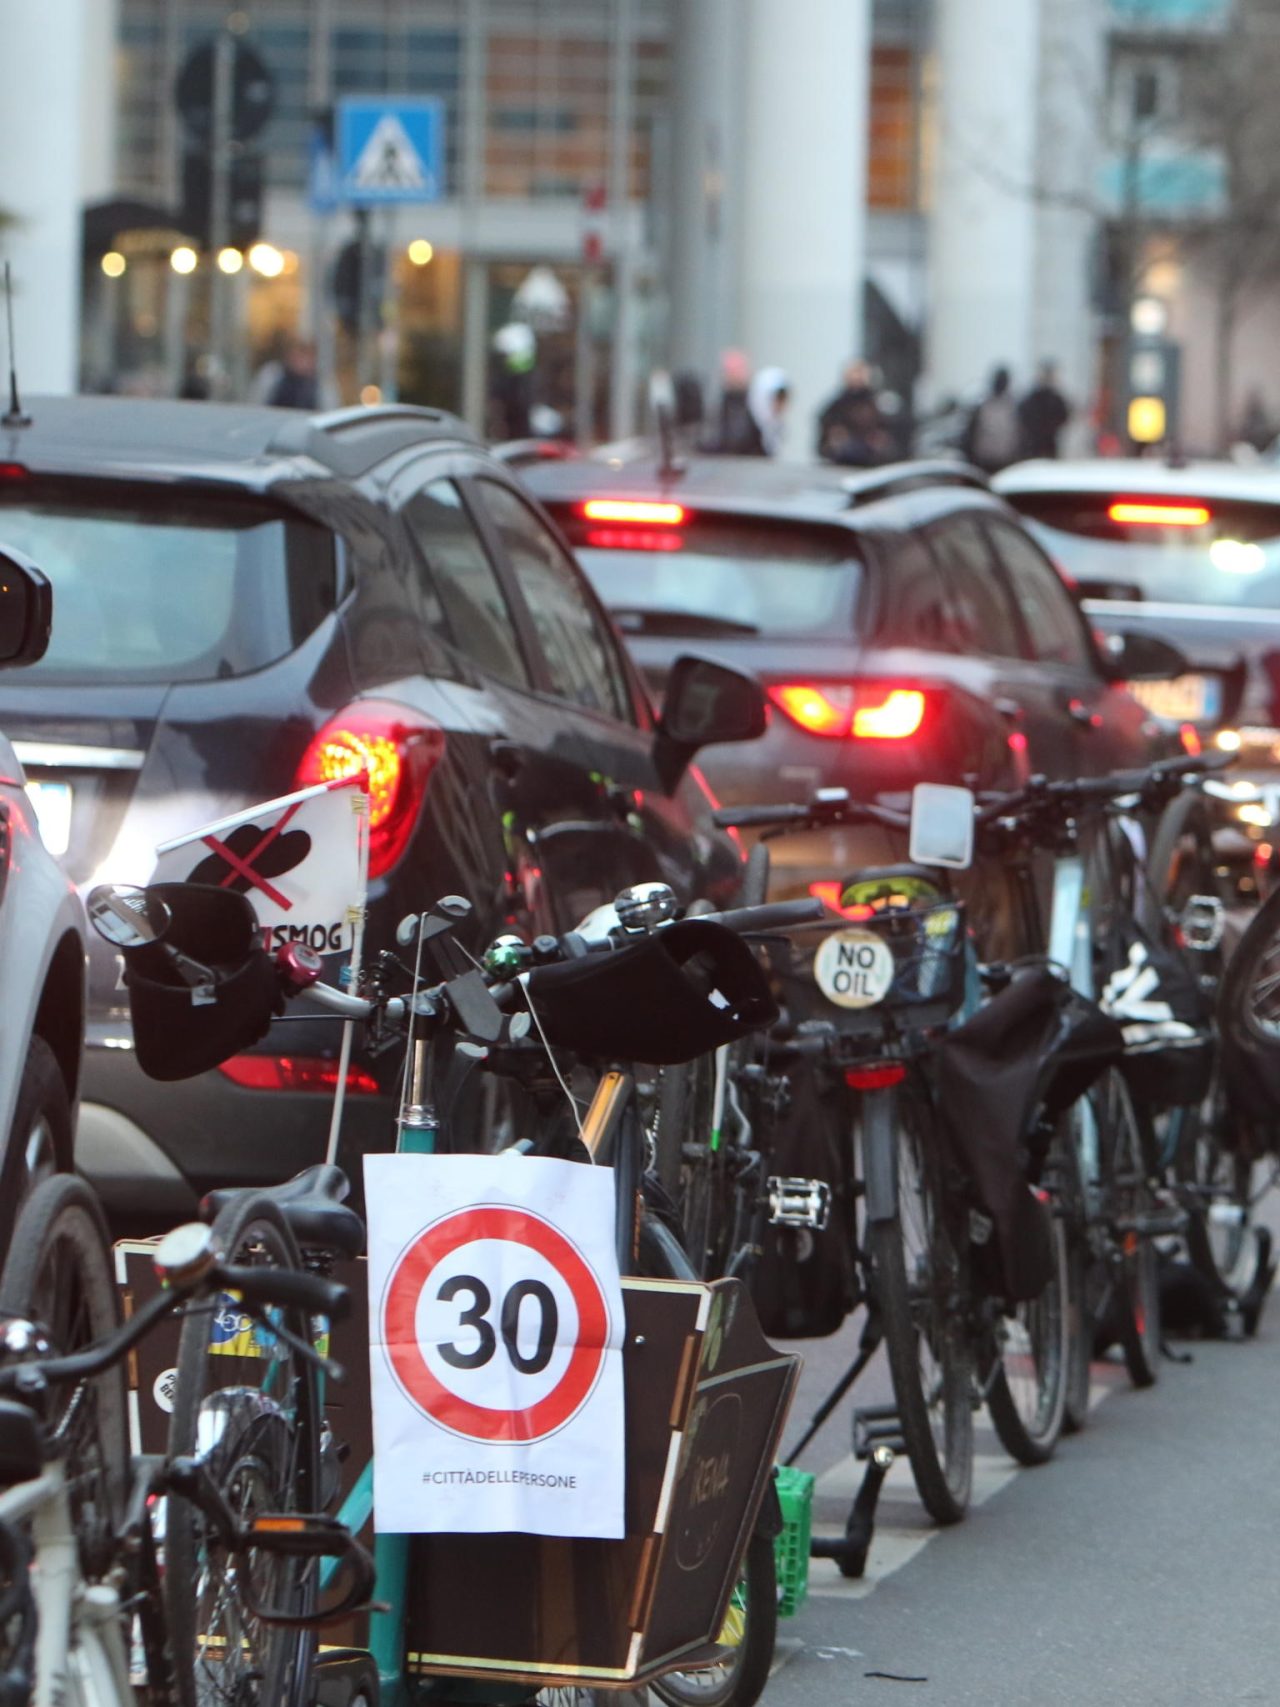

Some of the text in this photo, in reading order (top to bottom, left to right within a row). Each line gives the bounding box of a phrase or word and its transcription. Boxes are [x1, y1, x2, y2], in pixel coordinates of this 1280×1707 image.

[838, 943, 875, 969] NO
[833, 970, 875, 996] OIL
[436, 1274, 558, 1375] 30
[422, 1468, 577, 1489] #CITTÀDELLEPERSONE
